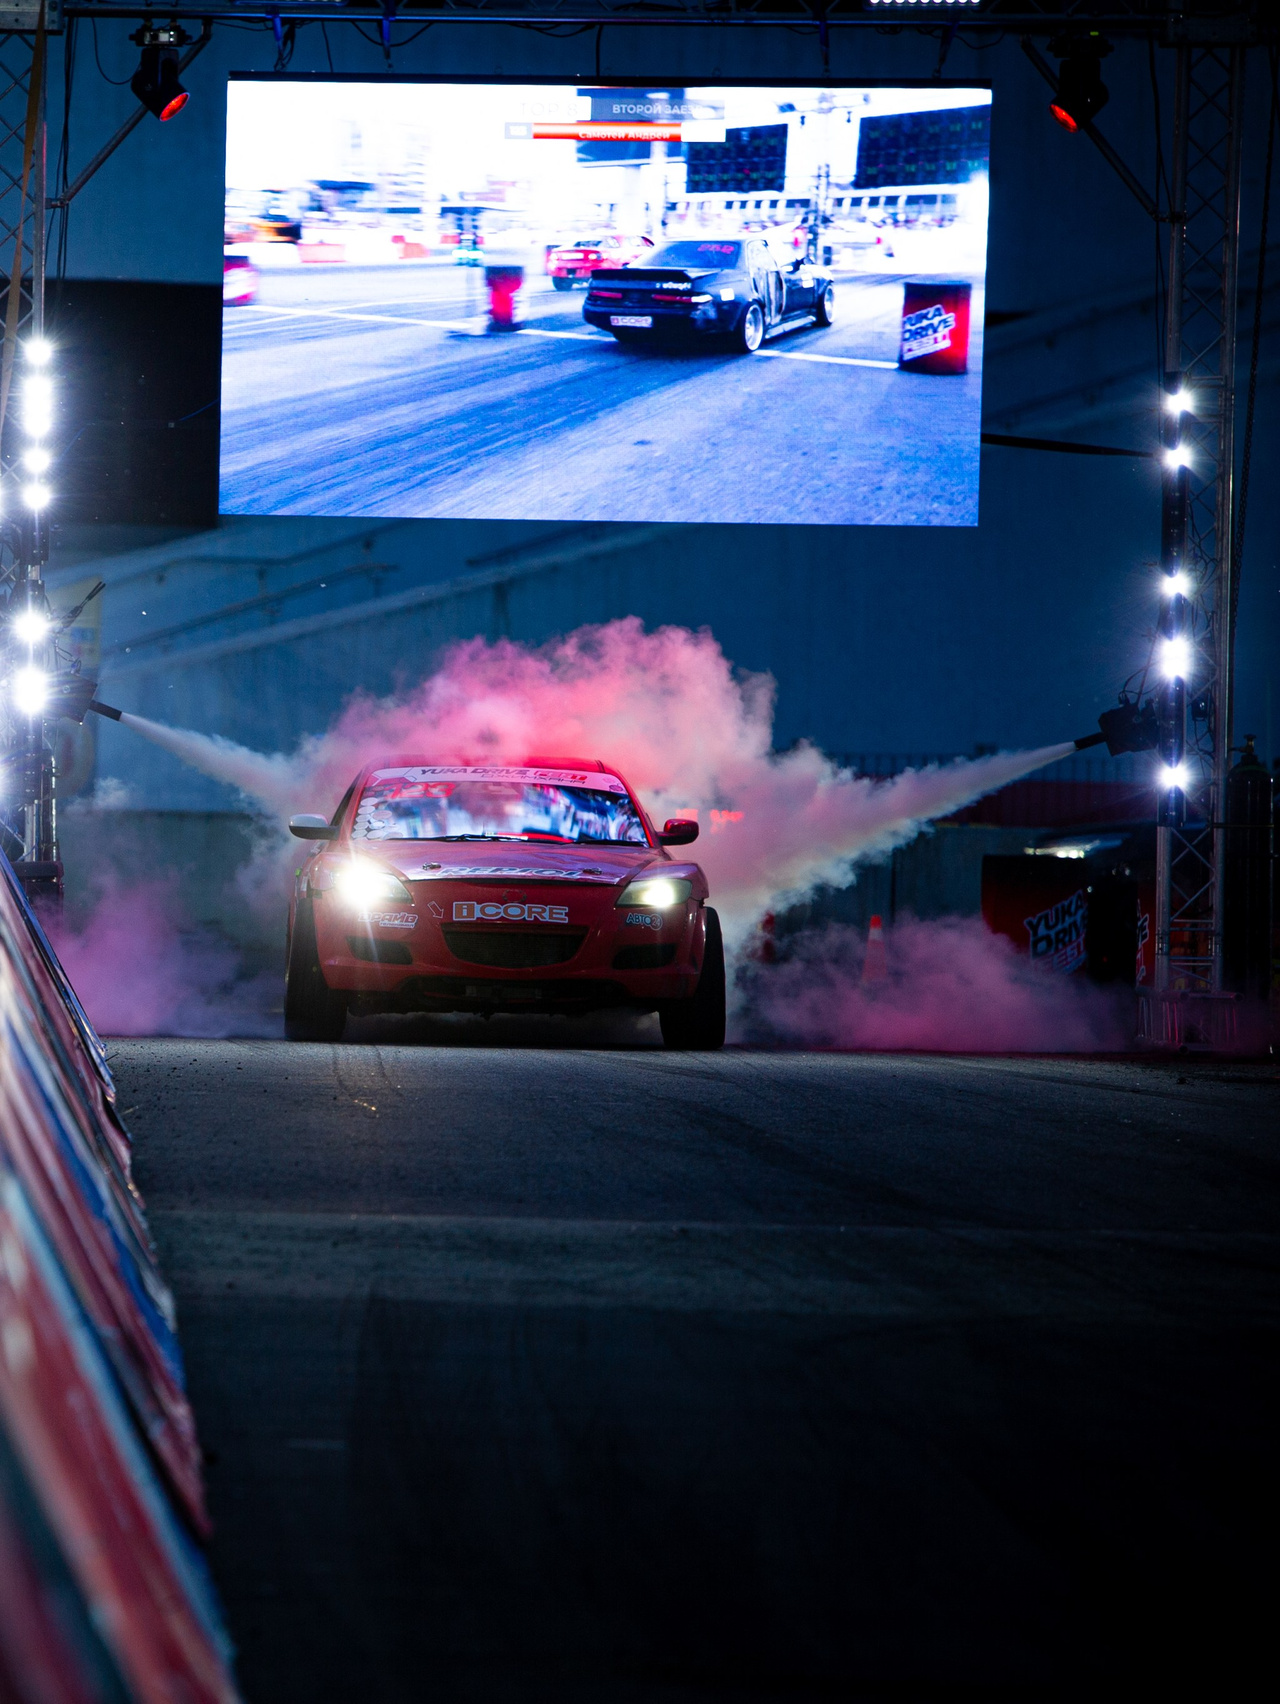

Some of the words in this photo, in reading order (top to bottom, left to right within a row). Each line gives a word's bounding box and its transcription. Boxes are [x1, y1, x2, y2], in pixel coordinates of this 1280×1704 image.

[612, 102, 662, 114] ВТОРОЙ
[420, 767, 468, 776] YUKA
[471, 767, 530, 776] DRIVE
[384, 781, 457, 799] 123
[1025, 891, 1084, 937] YUKA
